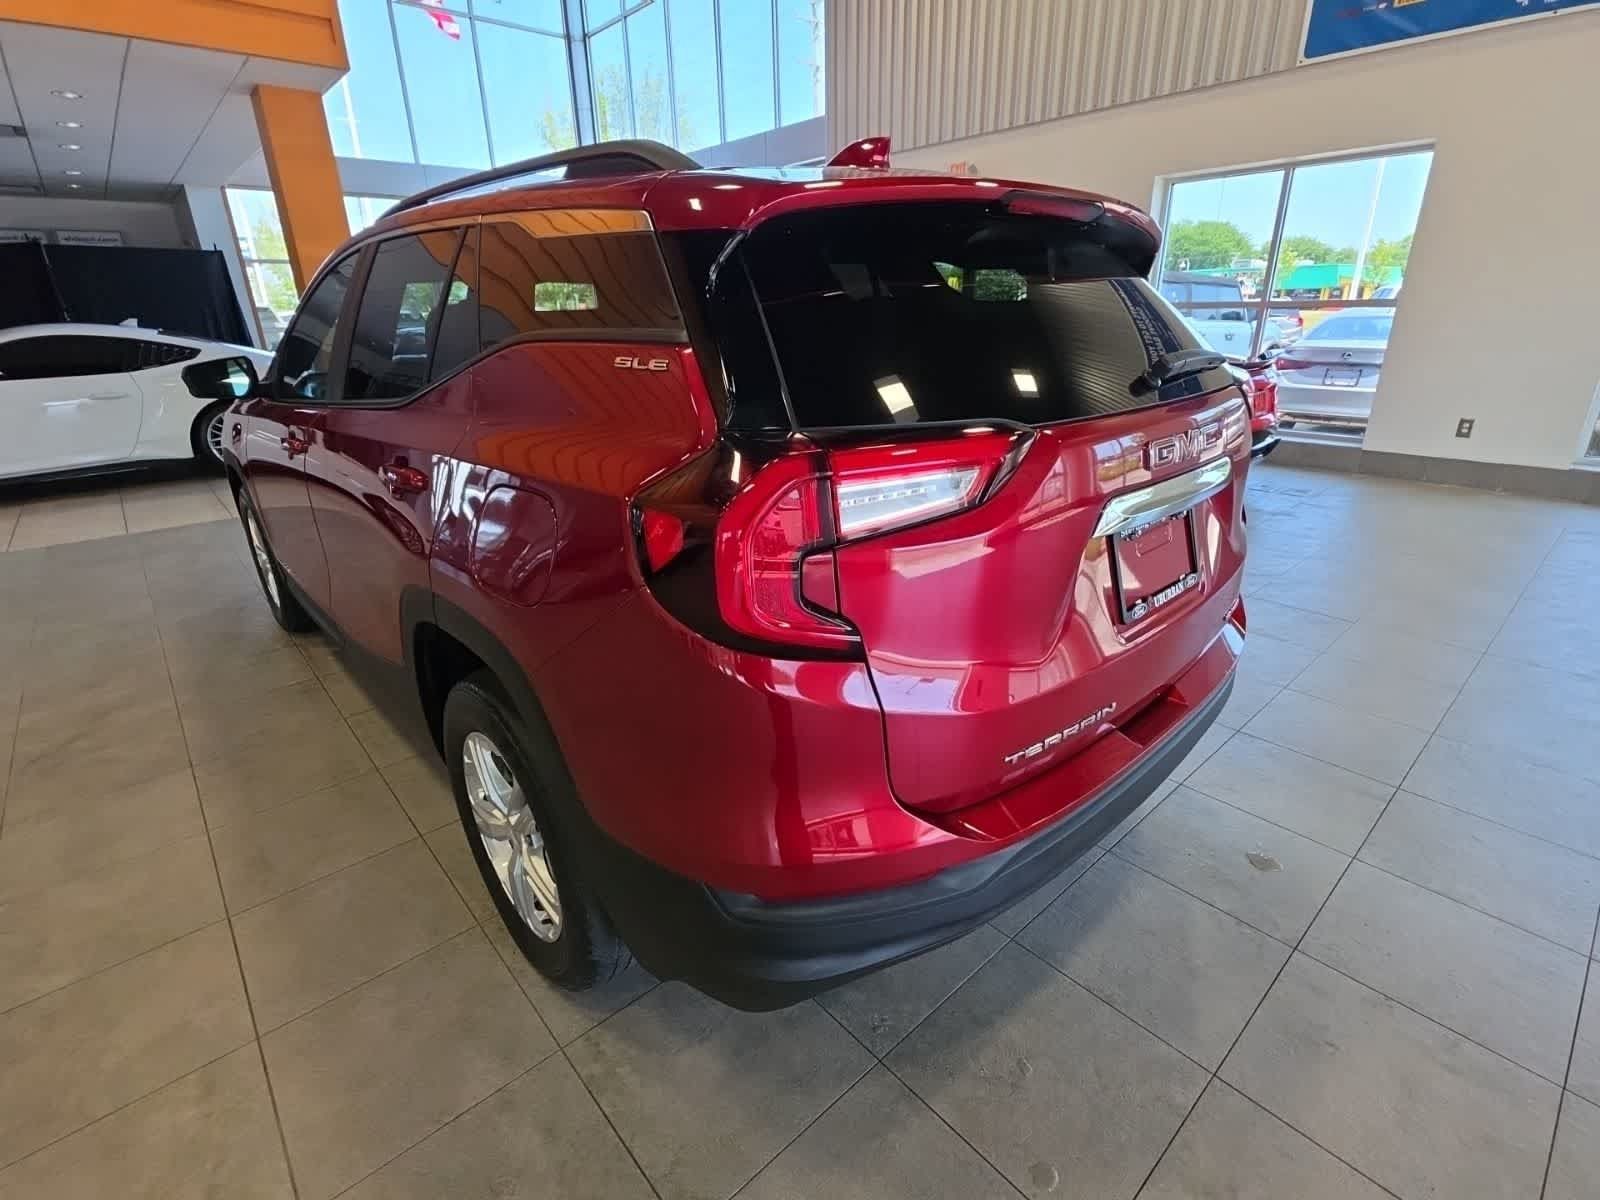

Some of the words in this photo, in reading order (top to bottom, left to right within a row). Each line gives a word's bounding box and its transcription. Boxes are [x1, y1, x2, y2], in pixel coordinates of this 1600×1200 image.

[614, 356, 669, 371] SLE
[1150, 422, 1224, 470] GMC
[1004, 702, 1117, 764] TERRAIN
